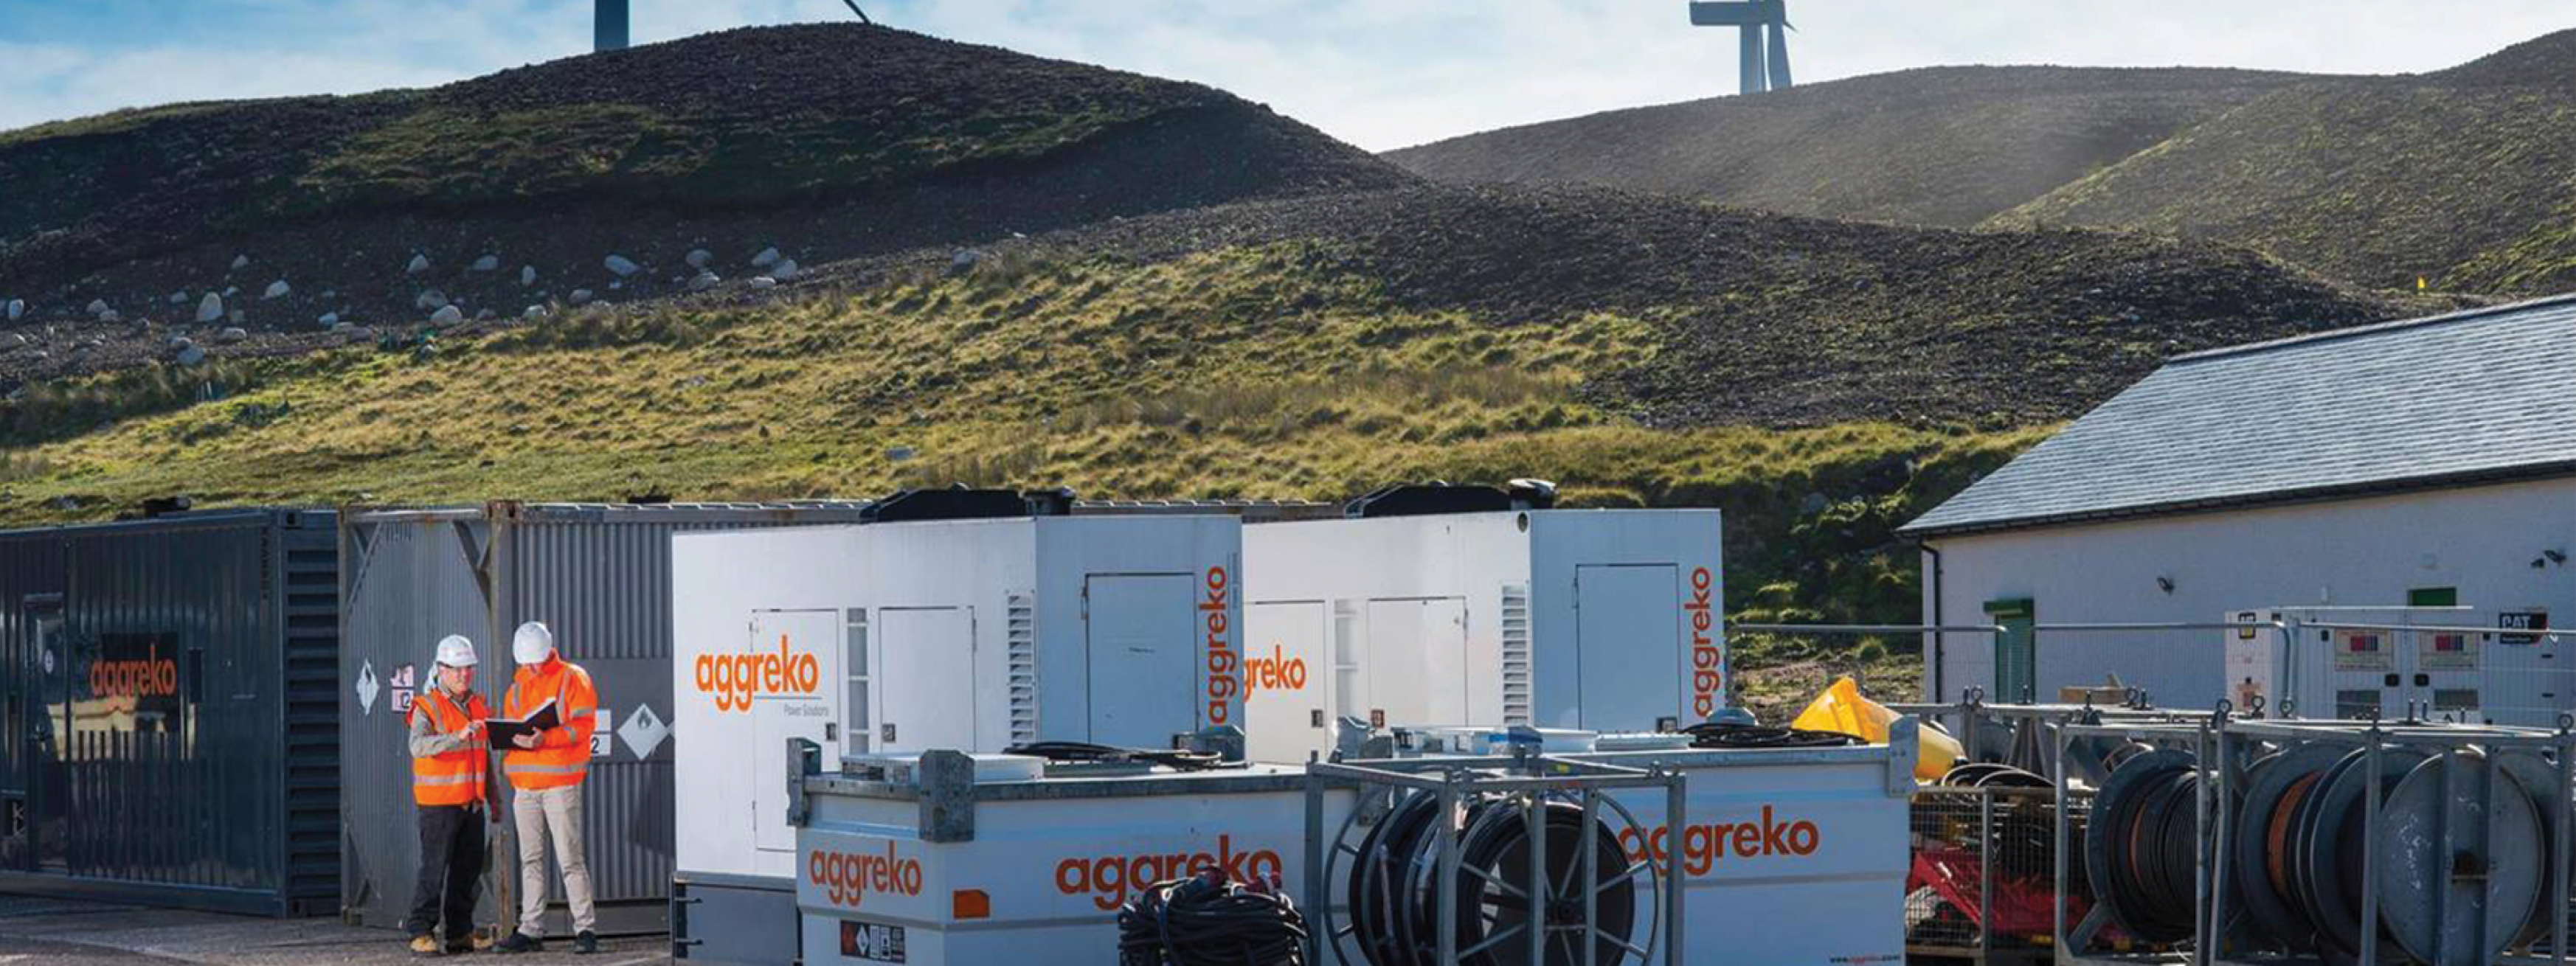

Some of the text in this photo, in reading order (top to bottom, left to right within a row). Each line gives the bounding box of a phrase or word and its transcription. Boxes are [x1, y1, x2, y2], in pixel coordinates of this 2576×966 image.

[91, 643, 178, 709] aggreko
[696, 634, 818, 712] aggreko
[1199, 566, 1236, 723] aggreko
[1684, 567, 1720, 717] aggreko
[811, 840, 921, 906] aggreko
[1618, 805, 1819, 876] aggreko
